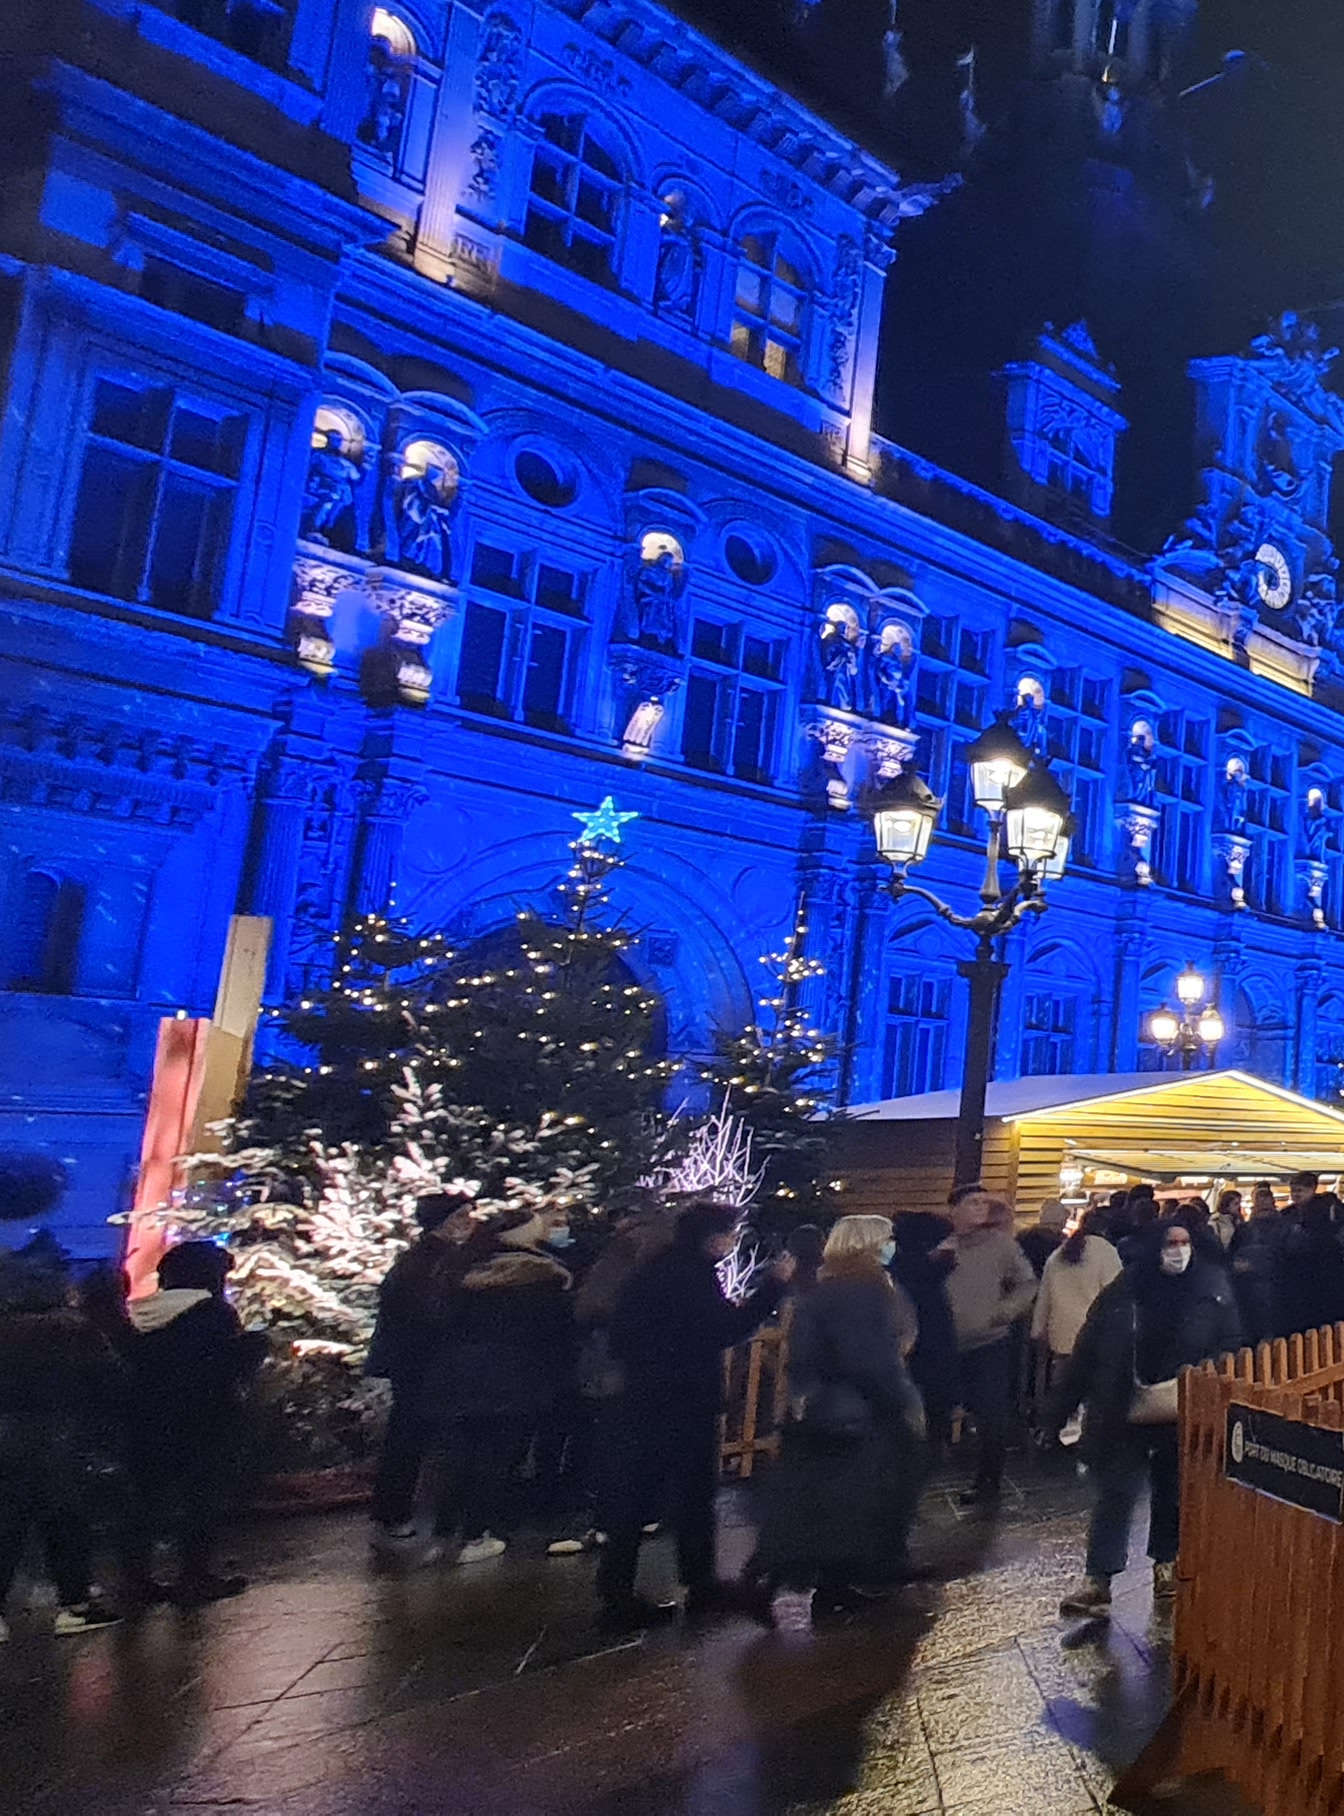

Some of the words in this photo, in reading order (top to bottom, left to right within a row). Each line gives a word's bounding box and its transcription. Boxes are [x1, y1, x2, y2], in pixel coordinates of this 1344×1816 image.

[1260, 1445, 1270, 1462] DU
[1271, 1450, 1297, 1473] MASQUE
[1297, 1459, 1344, 1488] OBLIGATOIRE
